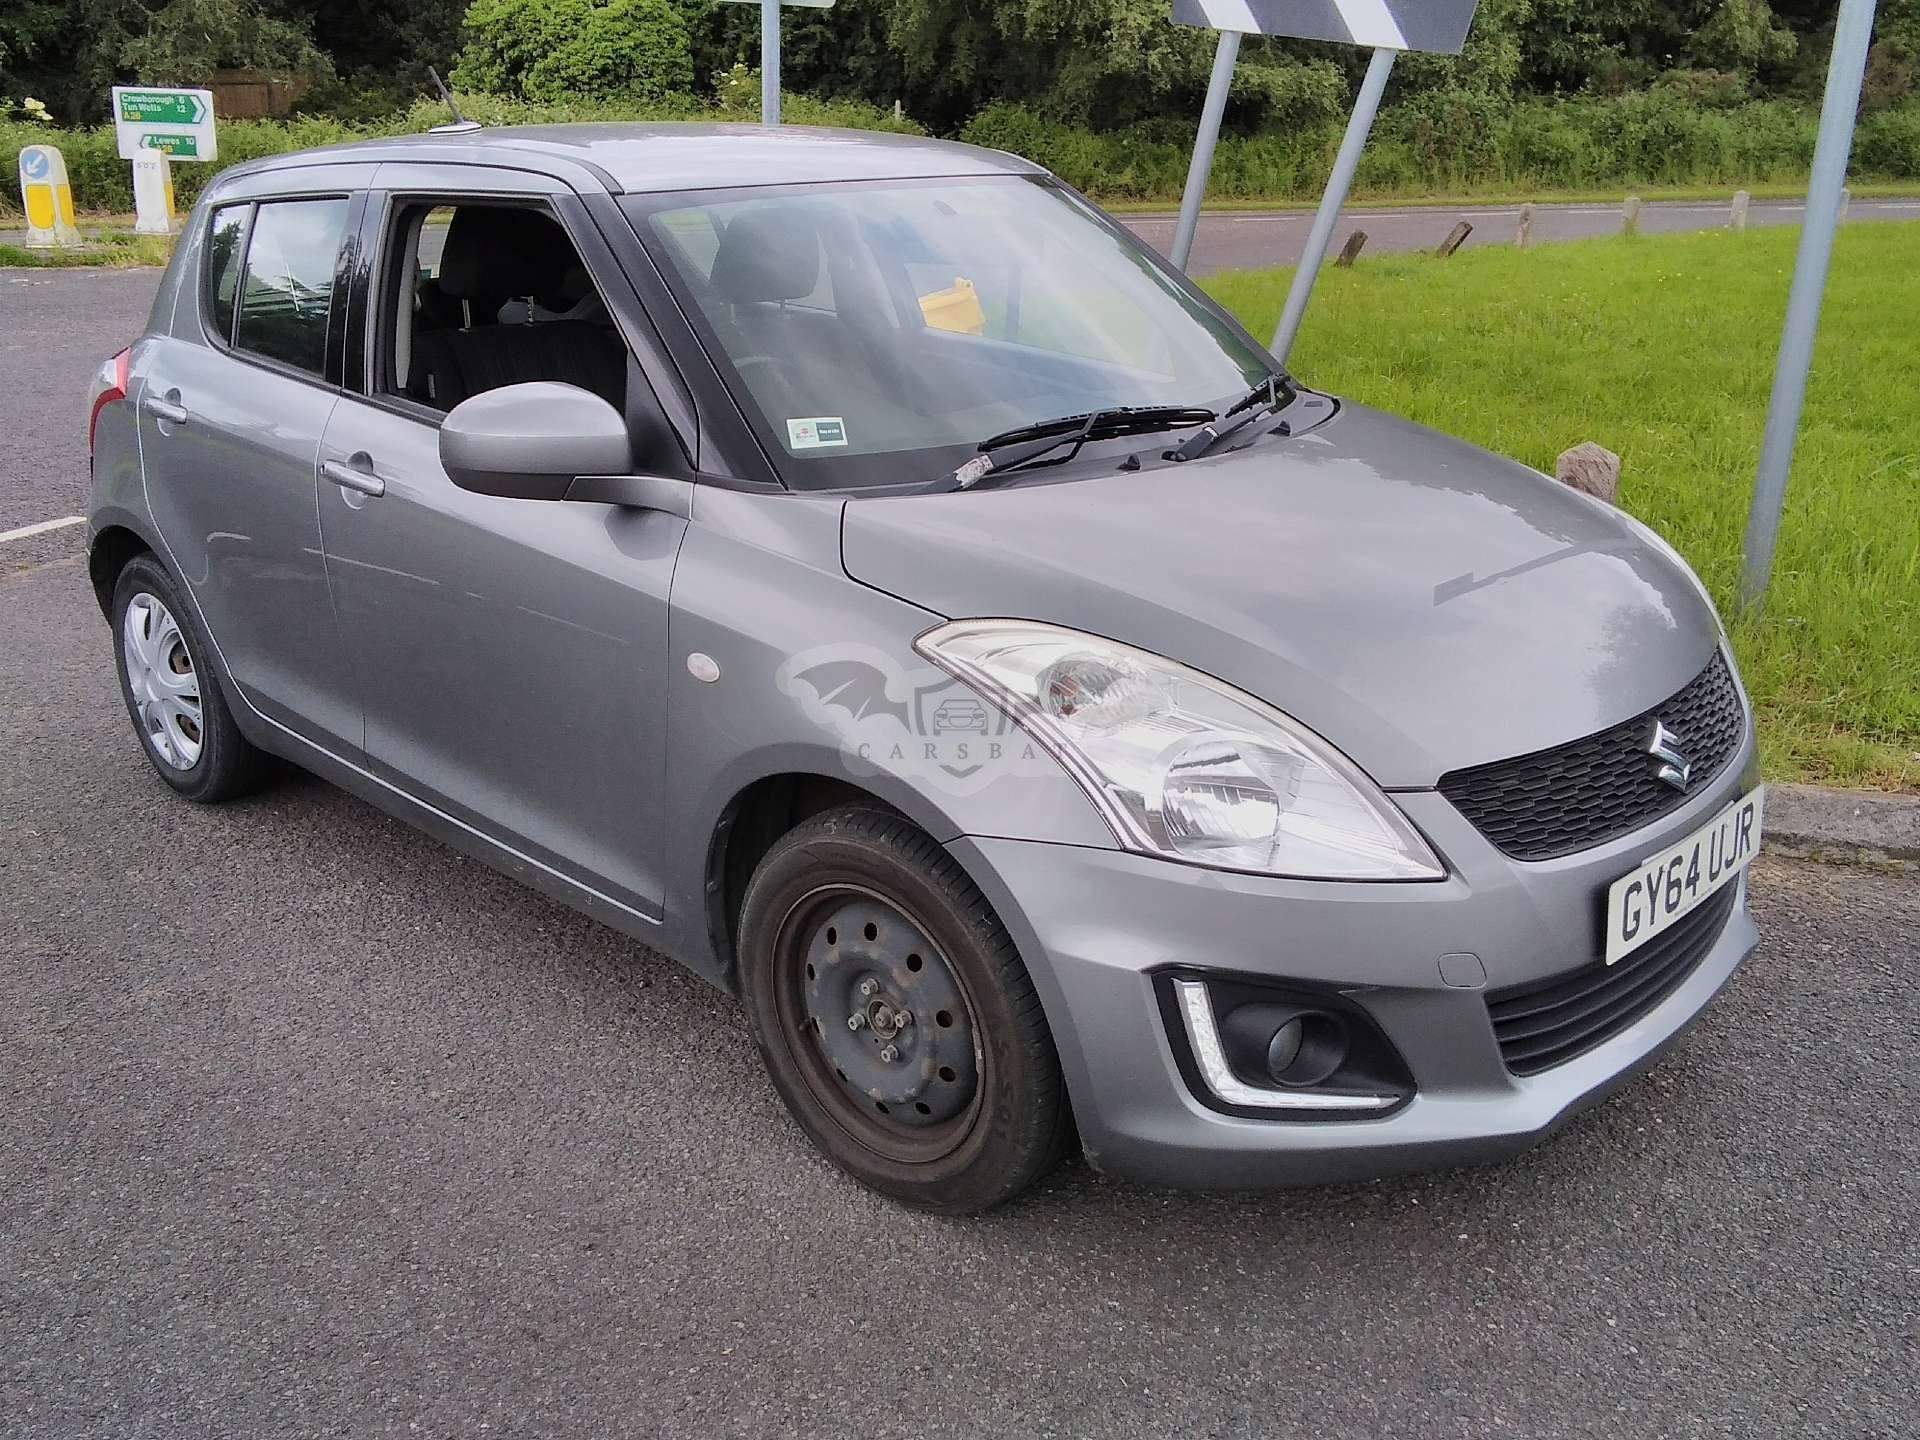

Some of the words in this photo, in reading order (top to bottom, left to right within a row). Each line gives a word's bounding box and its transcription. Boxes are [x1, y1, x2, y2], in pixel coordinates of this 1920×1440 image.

[121, 94, 175, 104] Crowborough
[122, 103, 138, 111] Tun
[138, 103, 162, 112] Wells
[177, 105, 186, 113] 12
[154, 136, 180, 145] Lewes
[186, 137, 195, 145] 10
[1622, 843, 1701, 942] GY64
[1709, 802, 1754, 883] UJR
